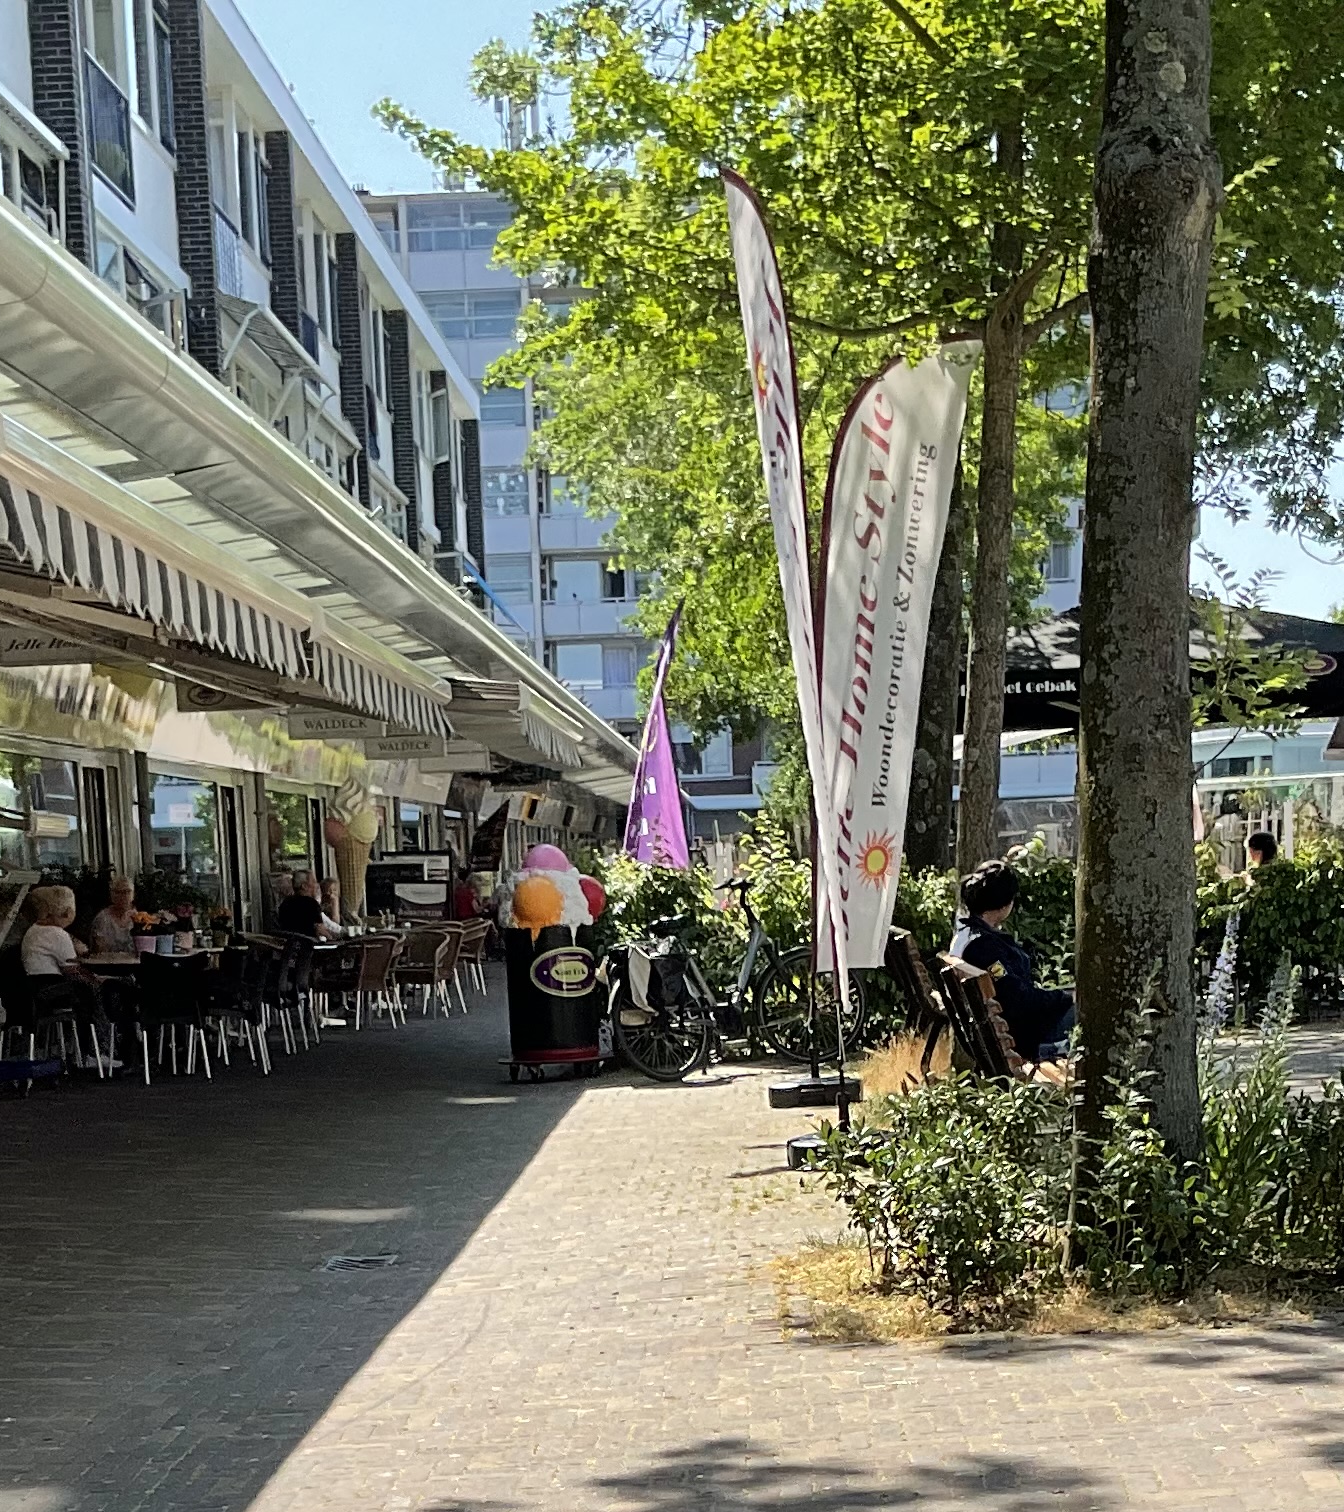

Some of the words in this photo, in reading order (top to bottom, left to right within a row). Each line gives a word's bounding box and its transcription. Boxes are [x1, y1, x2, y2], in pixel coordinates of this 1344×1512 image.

[854, 393, 897, 565] Style
[897, 443, 938, 584] Zonwering
[892, 583, 911, 612] &
[304, 718, 367, 730] WALDECK
[839, 574, 879, 772] Home
[870, 620, 907, 809] Woondecoratie
[377, 740, 430, 752] WALDECK
